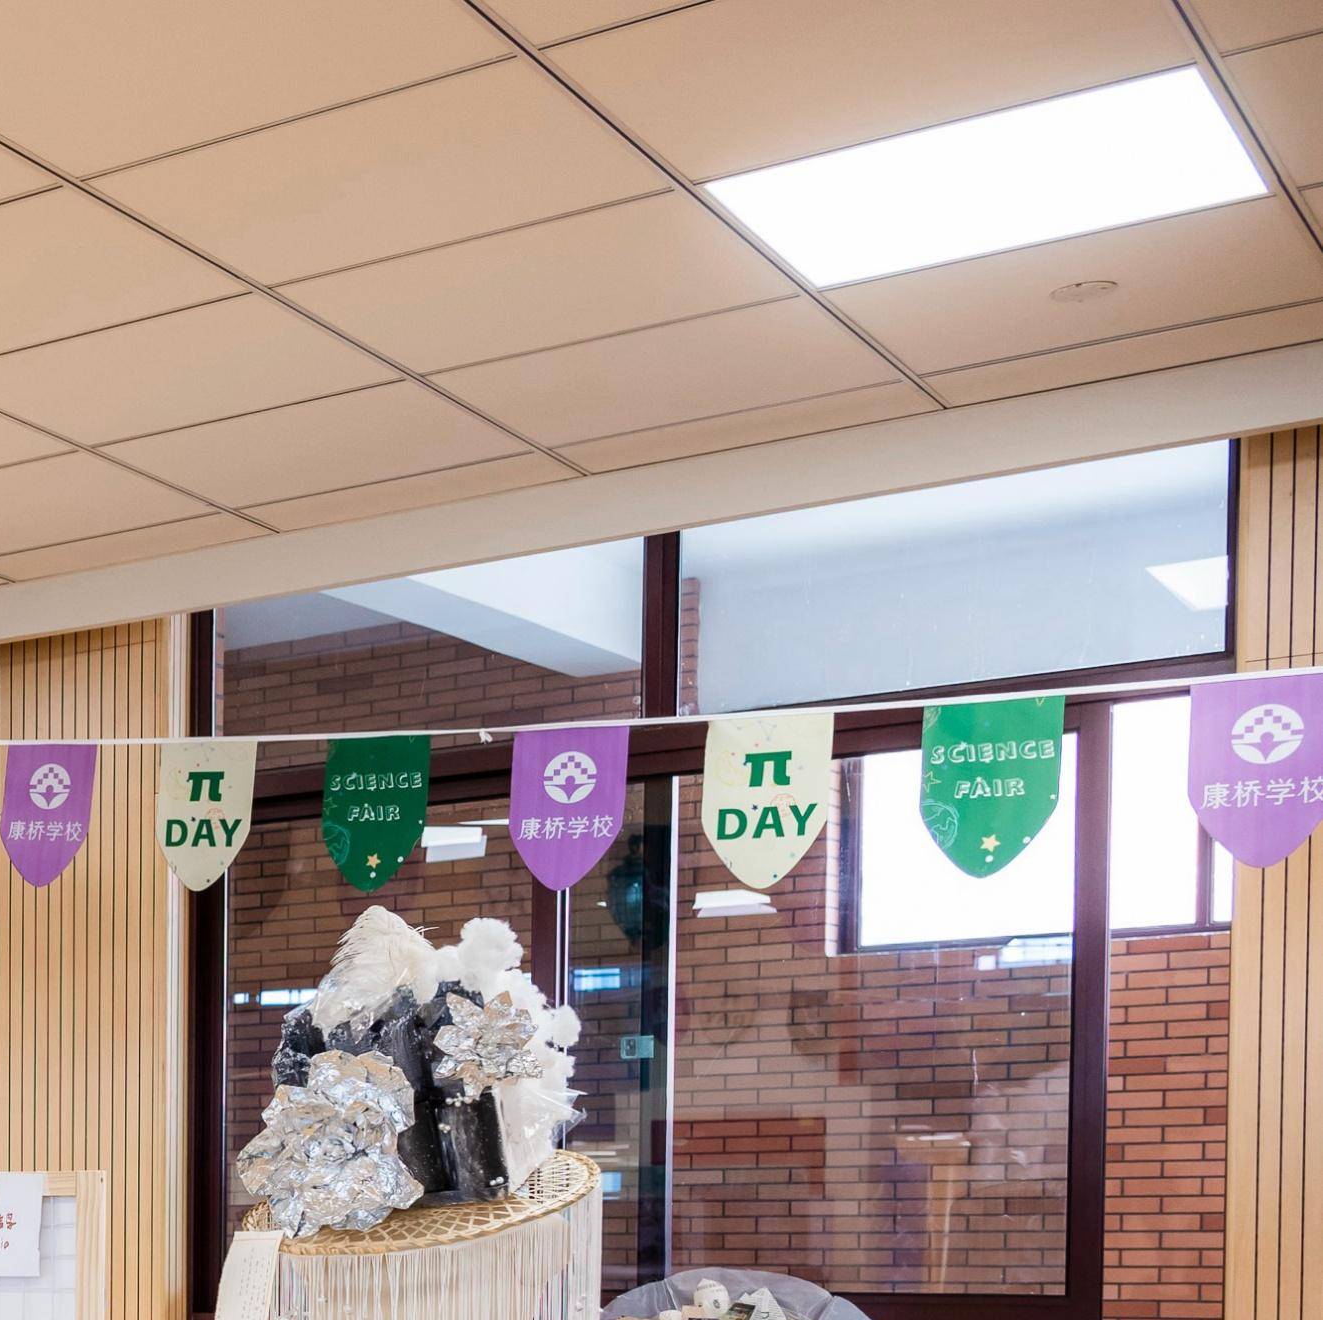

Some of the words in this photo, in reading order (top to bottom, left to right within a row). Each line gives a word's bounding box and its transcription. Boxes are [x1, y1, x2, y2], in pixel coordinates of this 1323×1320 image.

[930, 737, 1055, 766] SCIENCE
[329, 770, 423, 793] SCIENCE
[744, 749, 793, 788] π
[187, 770, 225, 803] π
[953, 775, 1026, 799] FAIR
[347, 802, 401, 823] FAIR
[716, 802, 818, 841] DAY
[7, 820, 83, 842] 康桥学校
[164, 818, 243, 848] DAY
[517, 815, 616, 842] 康桥学校
